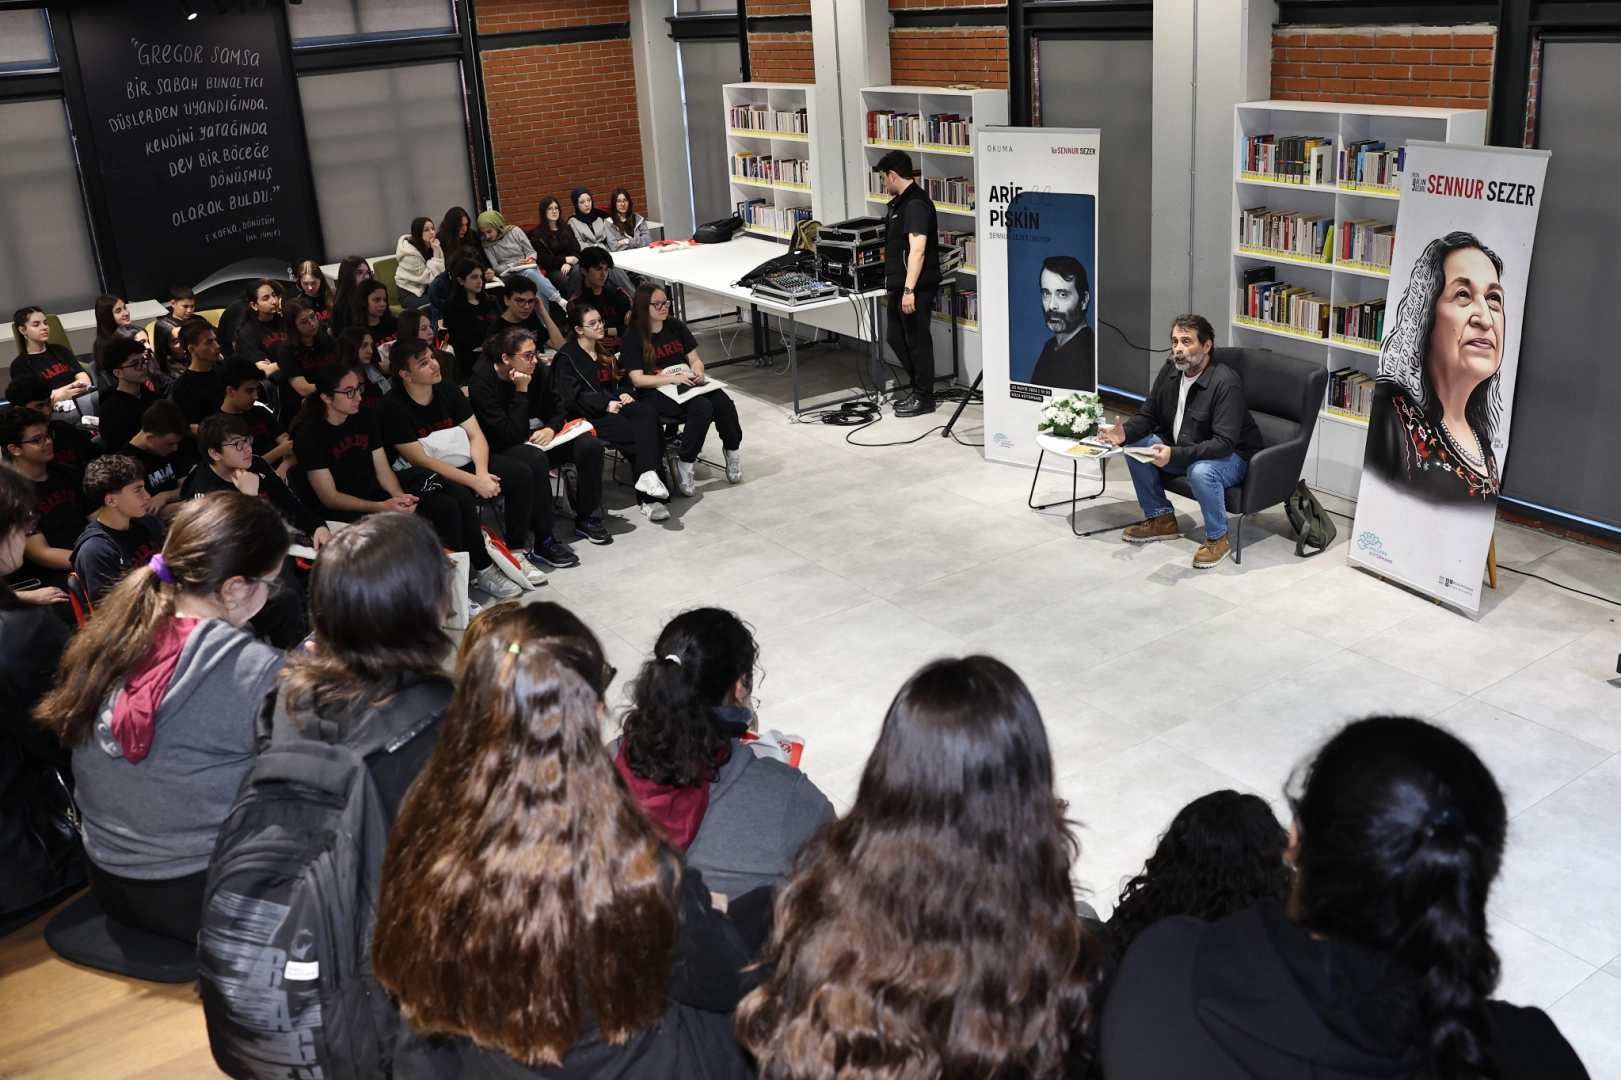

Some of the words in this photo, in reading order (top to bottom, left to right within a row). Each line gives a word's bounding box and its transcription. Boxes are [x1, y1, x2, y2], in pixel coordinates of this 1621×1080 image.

[126, 76, 151, 99] BİR
[155, 76, 198, 95] SABAH
[206, 76, 264, 90] BUNALTICI
[108, 104, 178, 133] DÜŞLERDEN
[146, 126, 194, 155] KENDİNİ
[199, 119, 268, 141] YATAĞINDA
[987, 145, 1013, 153] OKUMA
[169, 156, 193, 177] DEV
[199, 149, 221, 168] BİR
[223, 142, 269, 162] BÖCEĞE
[1057, 147, 1079, 155] SENNUR
[1079, 147, 1096, 155] SEZER
[210, 164, 273, 188] DÖNÜŞMÜŞ
[989, 181, 1023, 204] ARİF
[1427, 174, 1484, 200] SENNUR
[1486, 181, 1536, 206] SEZER
[172, 199, 224, 226] OLARAK
[990, 206, 1040, 233] PİŞKİN
